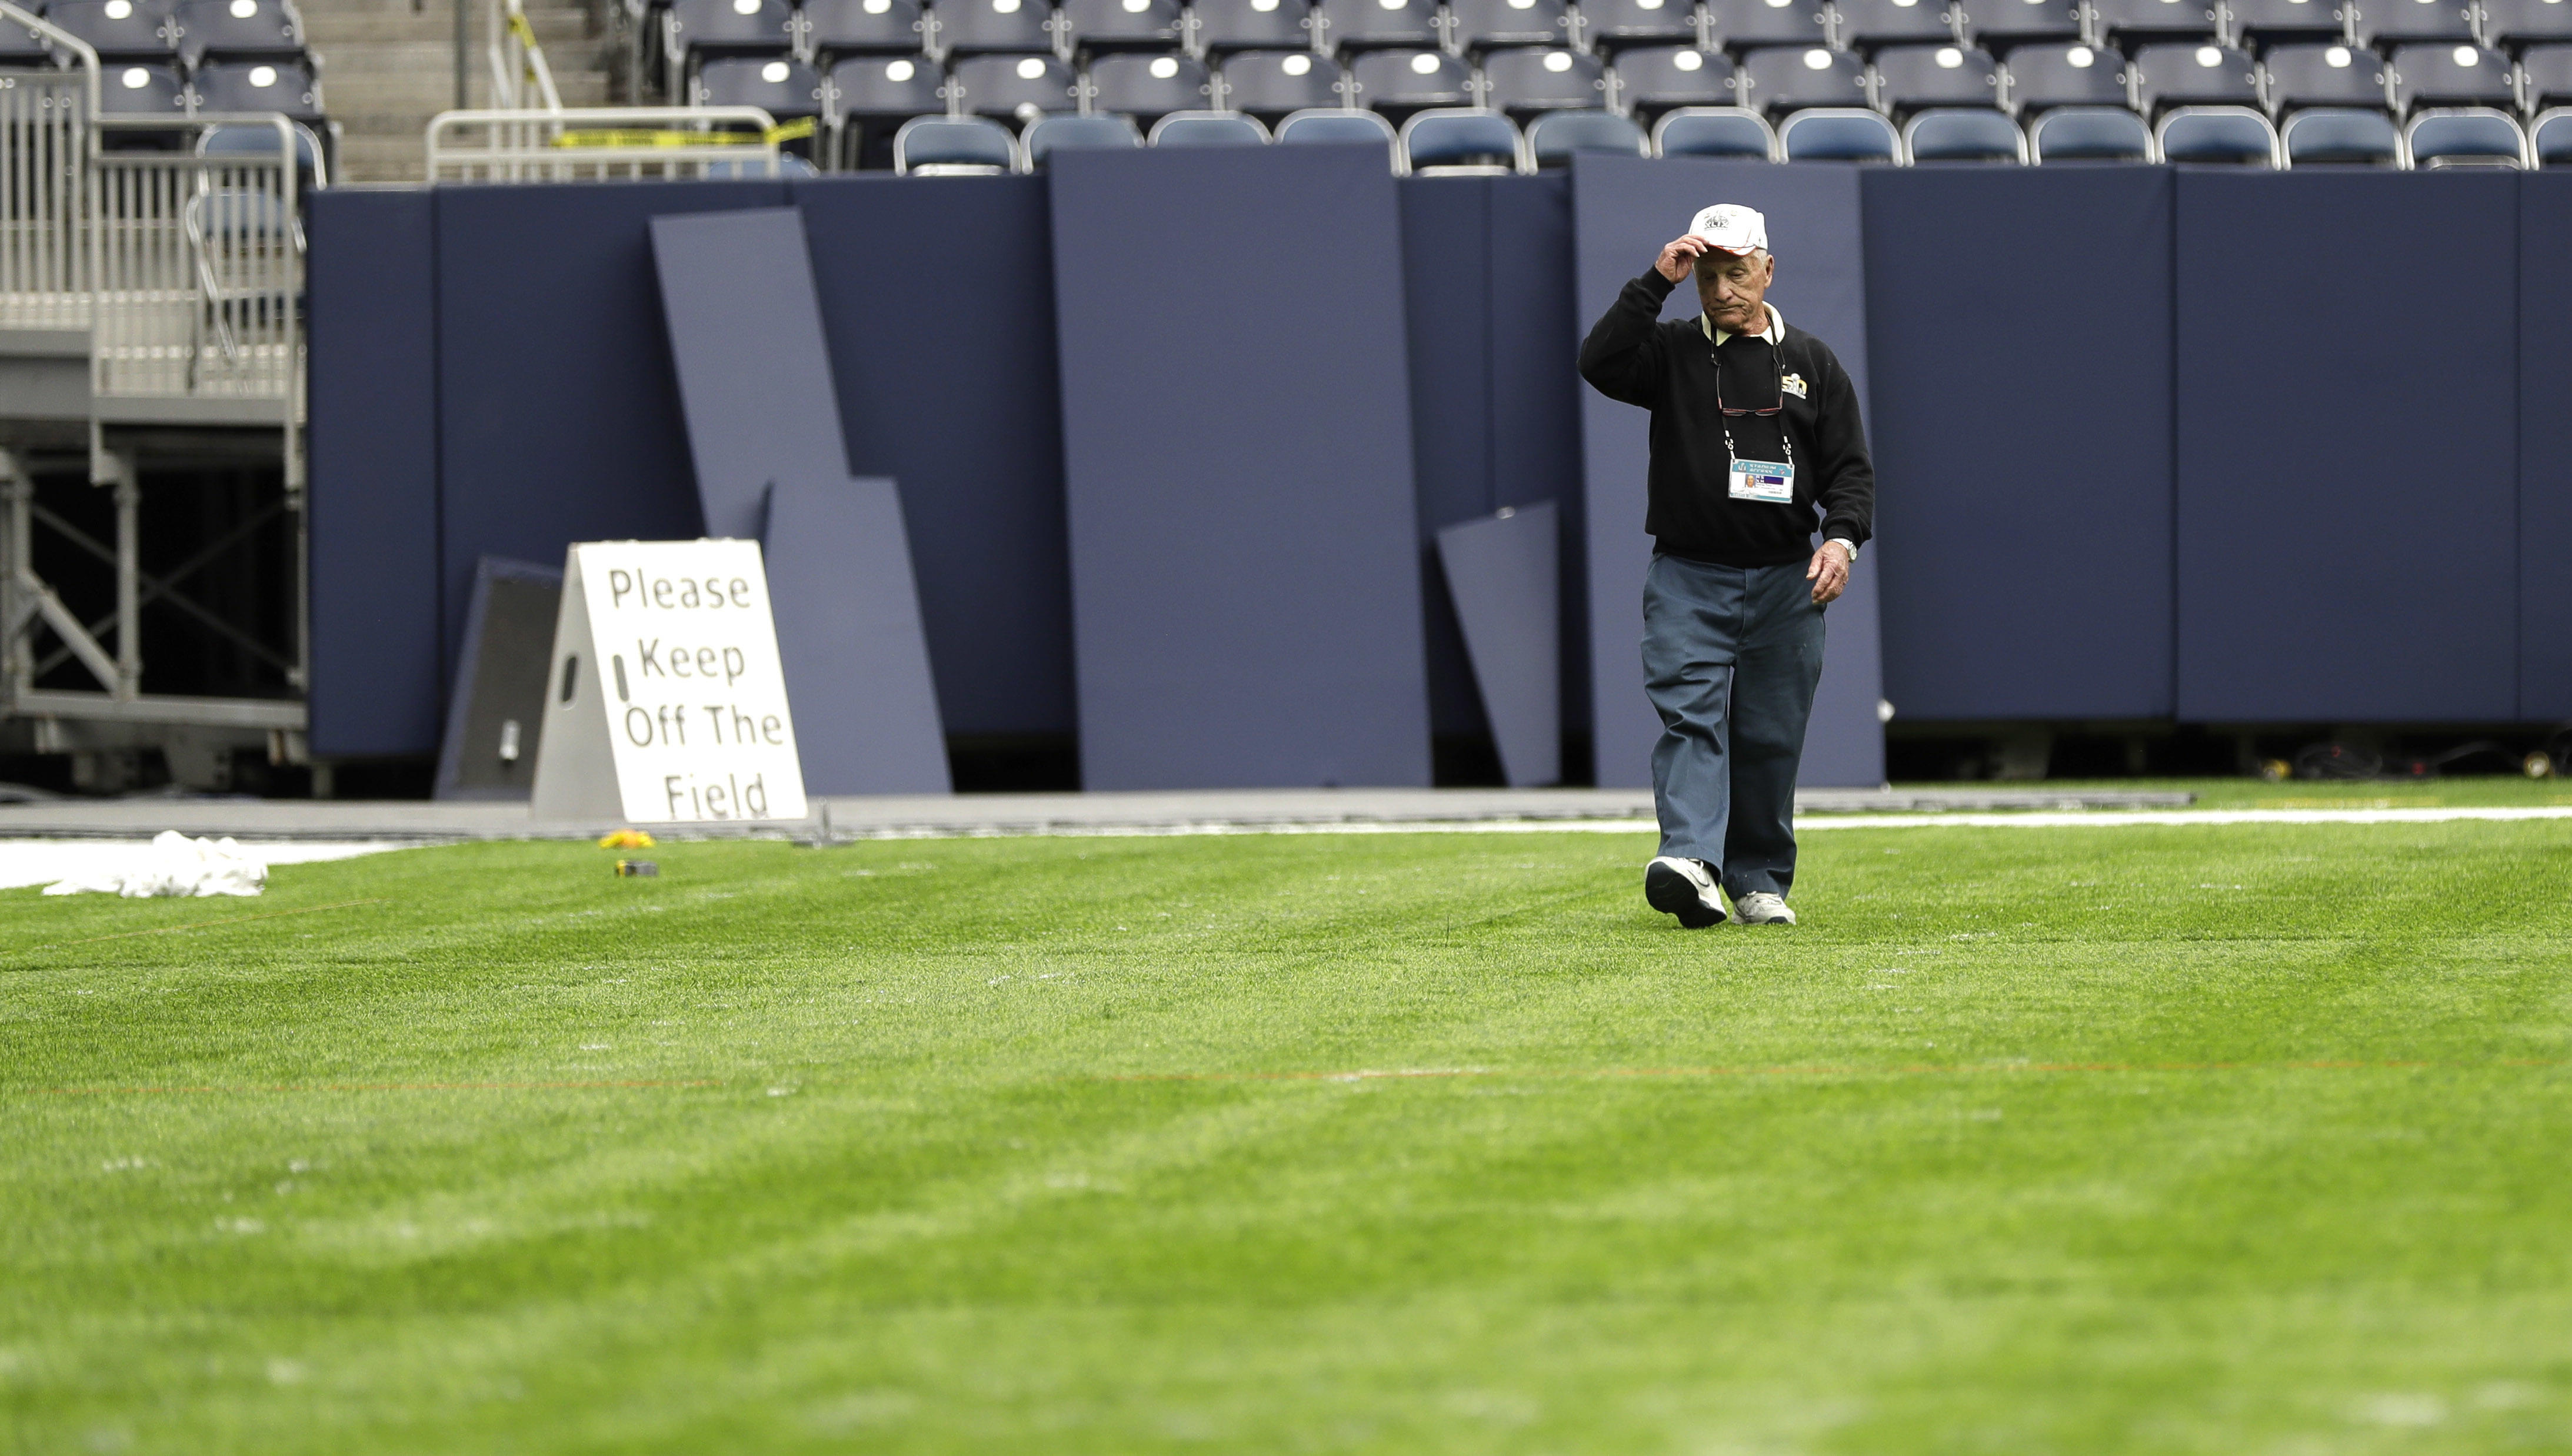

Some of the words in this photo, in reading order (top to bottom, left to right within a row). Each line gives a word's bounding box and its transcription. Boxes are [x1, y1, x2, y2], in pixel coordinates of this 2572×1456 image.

[609, 568, 751, 609] Please
[638, 638, 745, 687] Keep
[625, 705, 686, 747] Off
[704, 704, 783, 746] The
[664, 774, 768, 820] Field
